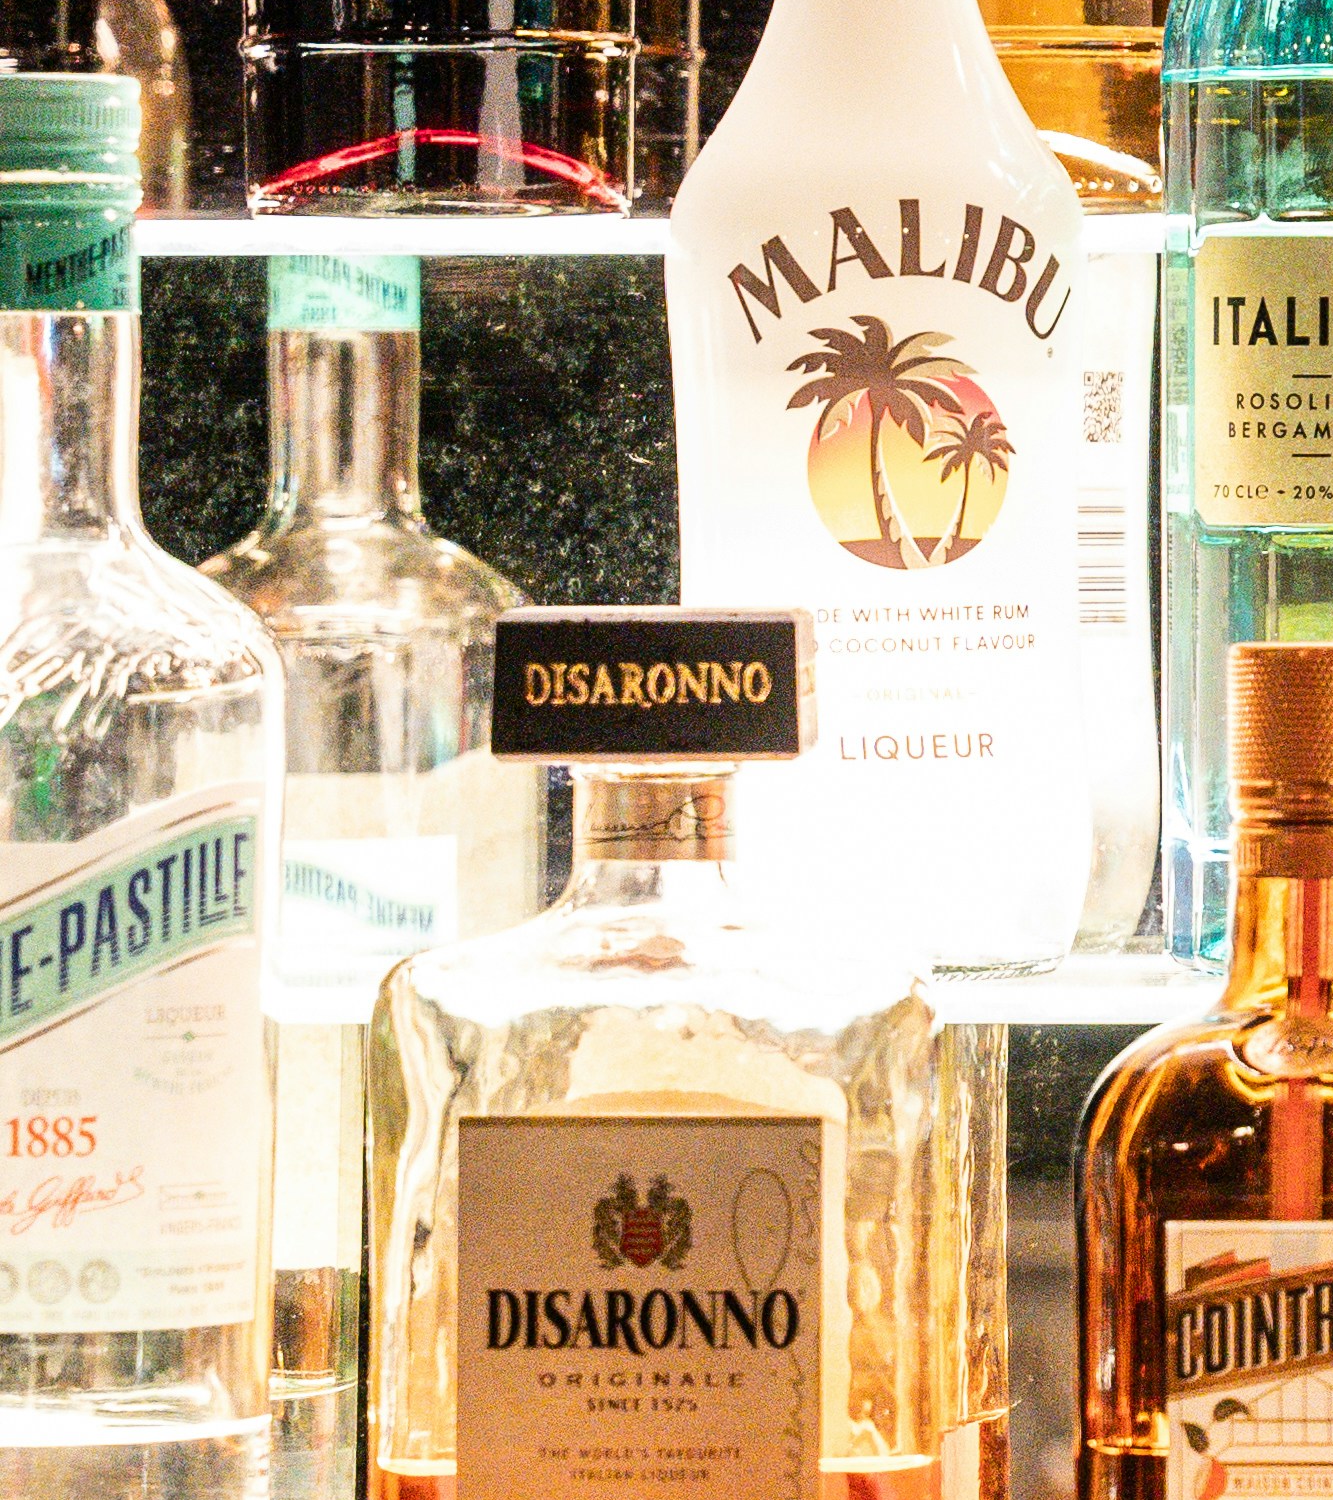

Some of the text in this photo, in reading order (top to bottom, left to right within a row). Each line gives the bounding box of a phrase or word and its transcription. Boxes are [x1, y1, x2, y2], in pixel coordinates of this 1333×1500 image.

[726, 198, 1073, 344] MALIBU
[1292, 484, 1333, 500] 20%
[850, 603, 1031, 623] WITH WHITE RUM
[827, 632, 1036, 654] COCONUT FLAVOUR
[524, 661, 773, 708] DISARONNO
[839, 732, 996, 761] LIQUEUR
[4, 1114, 98, 1158] 1885
[486, 1288, 800, 1356] DISARONNO
[537, 1371, 746, 1389] ORIGINALE
